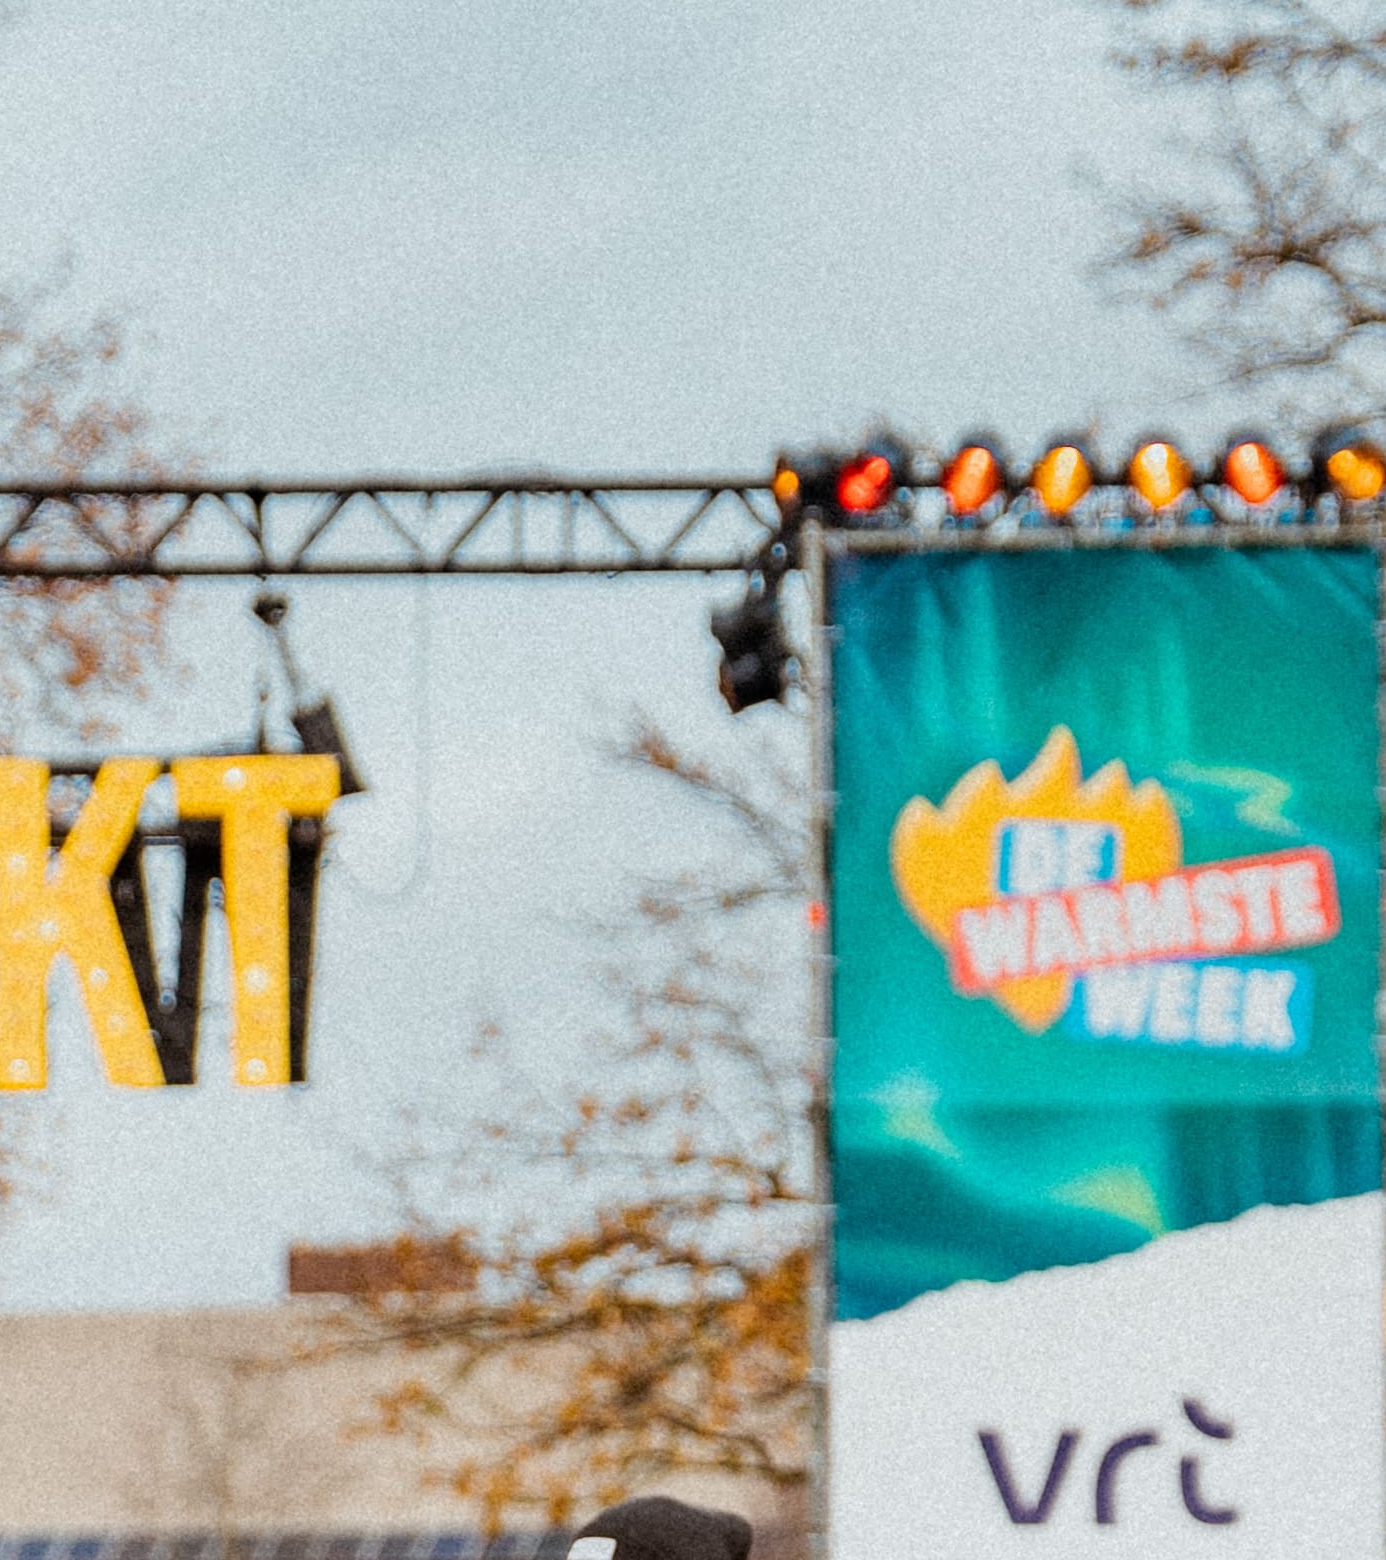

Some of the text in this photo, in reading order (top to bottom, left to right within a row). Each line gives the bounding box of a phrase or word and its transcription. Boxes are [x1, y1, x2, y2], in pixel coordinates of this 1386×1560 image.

[959, 859, 1326, 980] WARMSTE
[1084, 963, 1298, 1049] WEEK
[976, 1396, 1238, 1524] vrt
